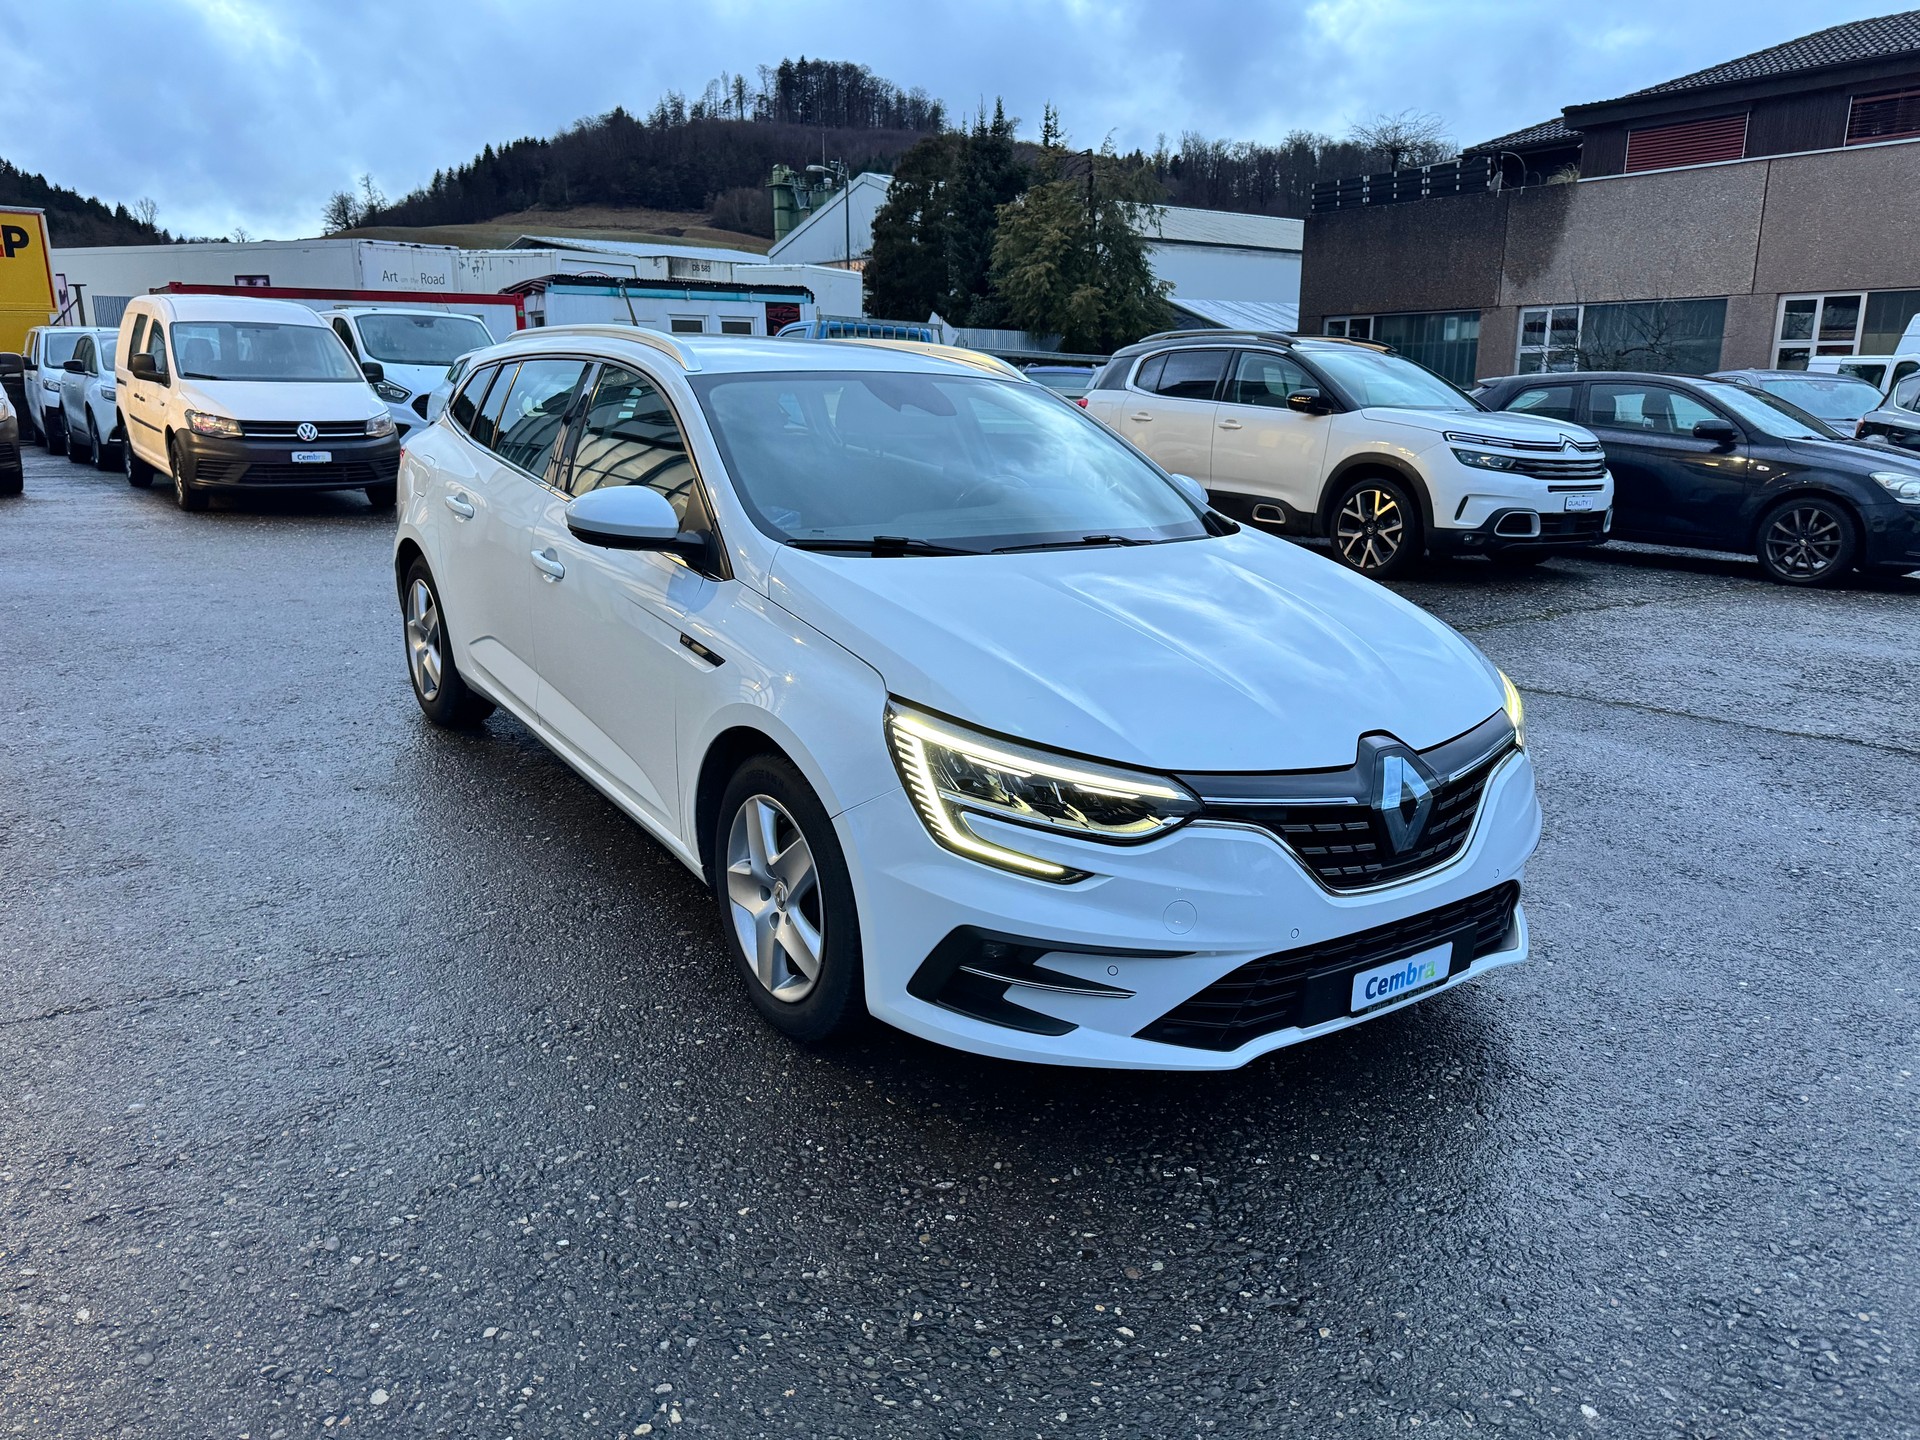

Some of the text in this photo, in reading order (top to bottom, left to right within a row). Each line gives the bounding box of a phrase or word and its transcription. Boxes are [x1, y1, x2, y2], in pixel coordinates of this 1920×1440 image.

[0, 224, 30, 258] P
[382, 270, 398, 283] Art
[420, 272, 446, 285] Road
[297, 453, 327, 461] Cembra
[1365, 961, 1436, 1000] Cembra
